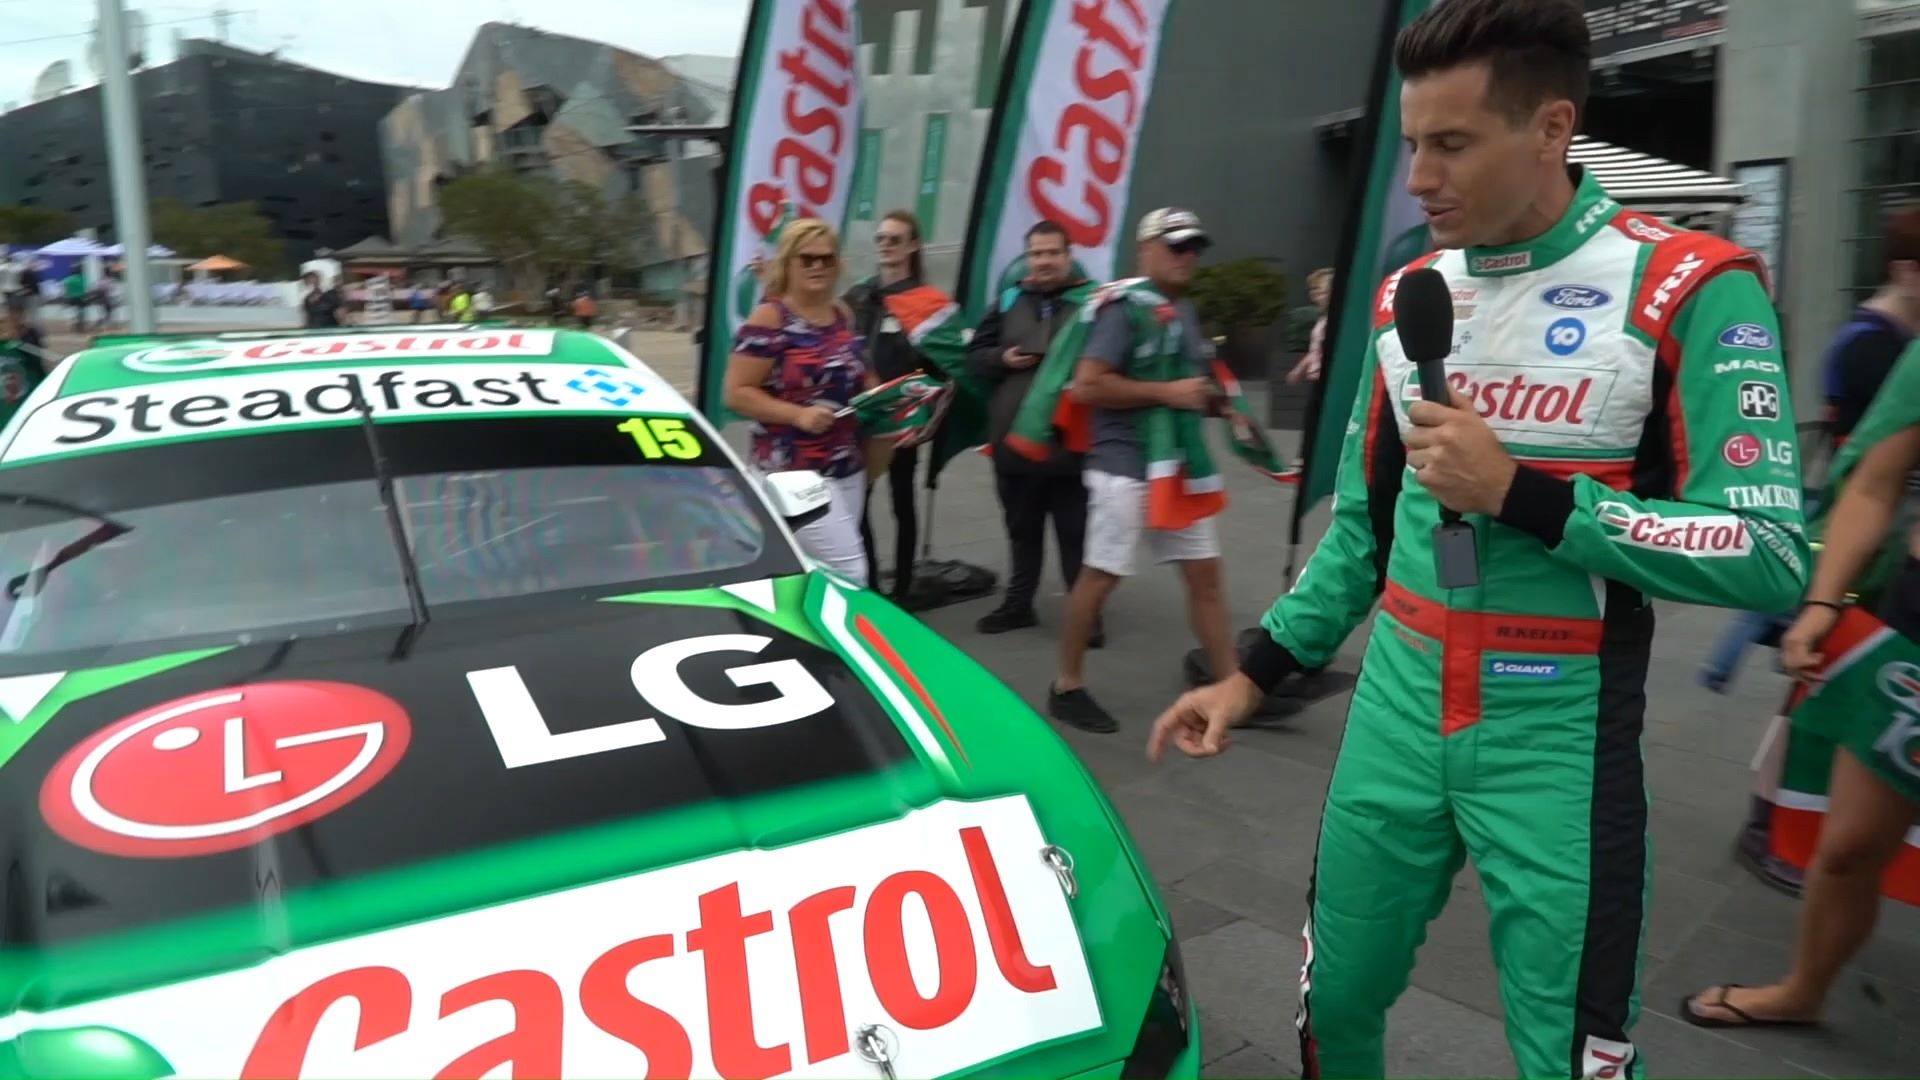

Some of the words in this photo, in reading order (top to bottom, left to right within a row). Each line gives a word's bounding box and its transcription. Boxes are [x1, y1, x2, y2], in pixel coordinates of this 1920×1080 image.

[1483, 254, 1528, 270] Castrol
[1553, 287, 1600, 306] Ford
[1643, 252, 1704, 321] HRX
[242, 333, 525, 360] Castrol
[1551, 326, 1580, 346] 10
[55, 370, 561, 445] Steadfast
[1742, 385, 1777, 415] PPG
[616, 417, 703, 460] 15
[1766, 438, 1793, 465] LG
[1631, 516, 1746, 551] Castrol
[1505, 664, 1556, 675] GIANT
[466, 633, 836, 769] LG
